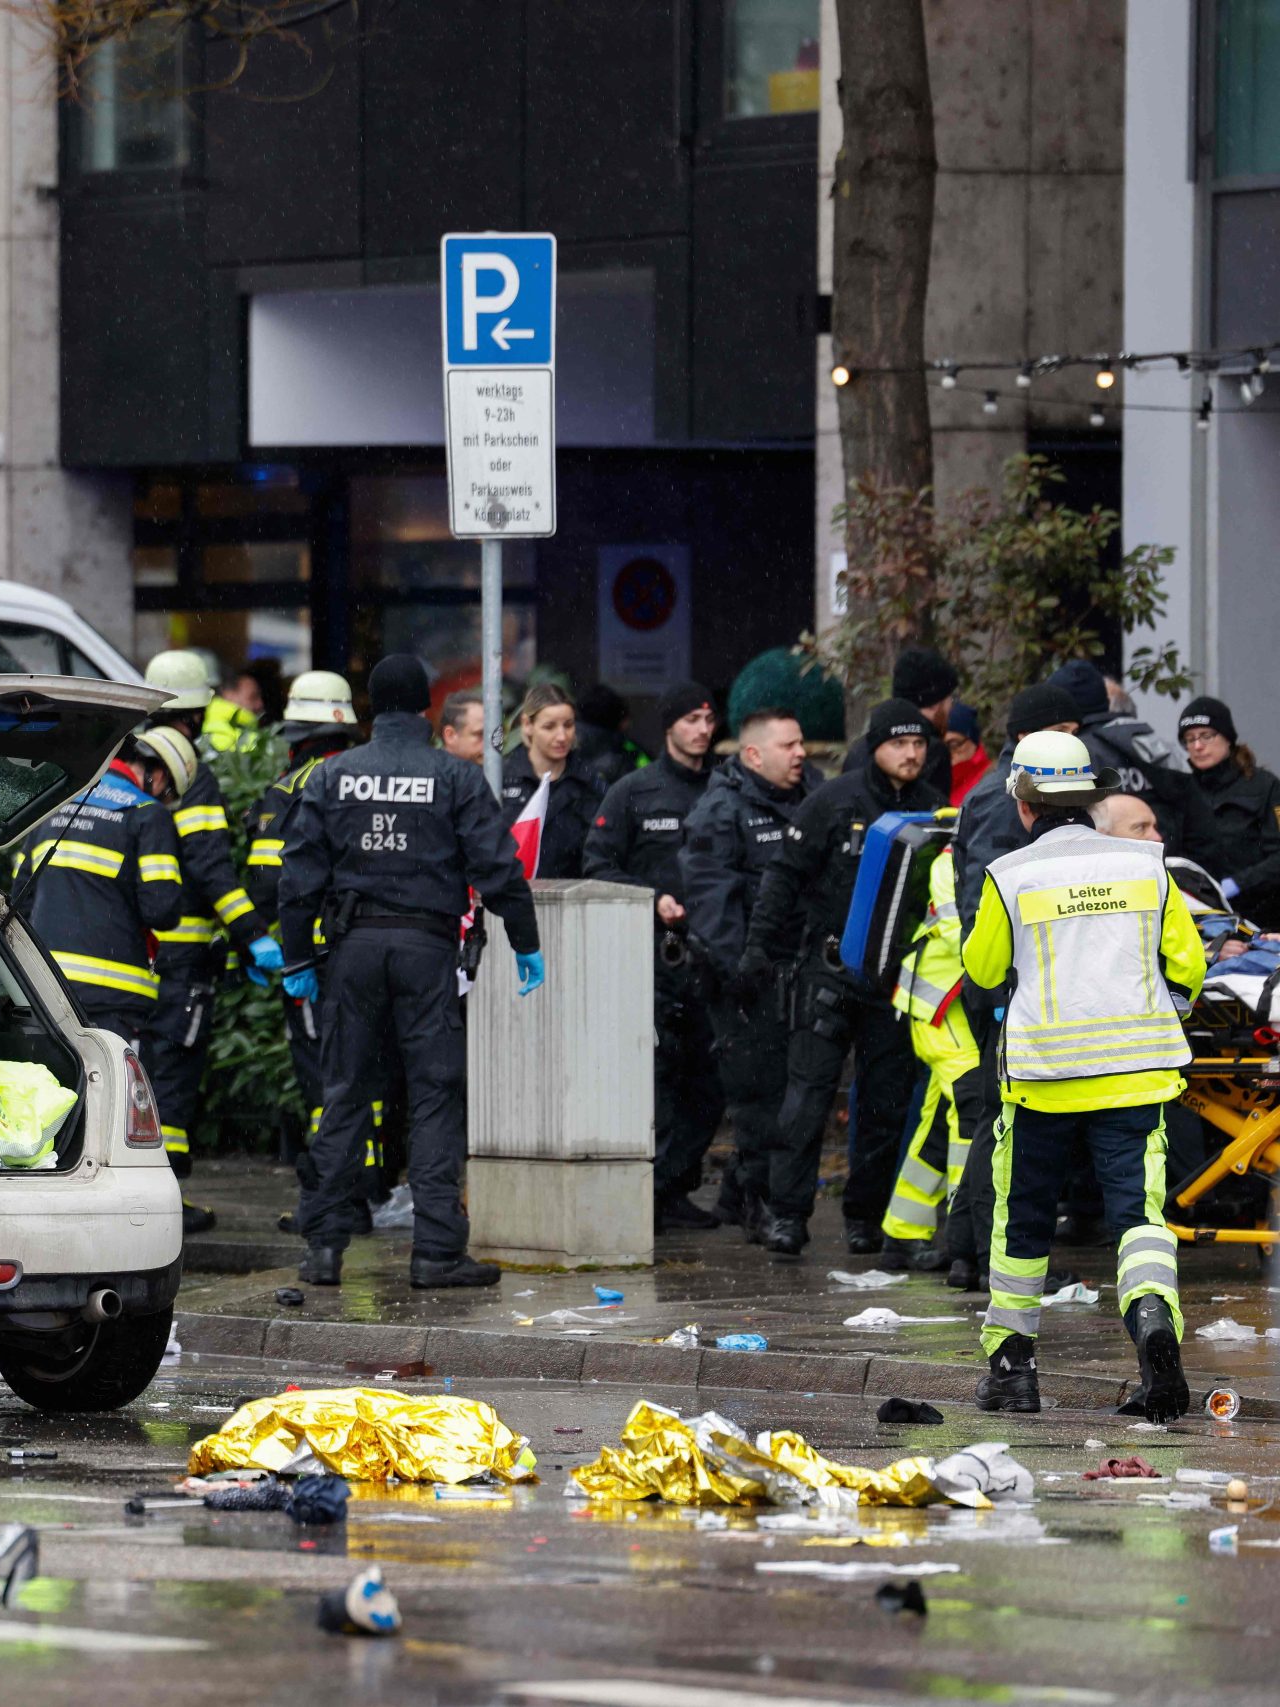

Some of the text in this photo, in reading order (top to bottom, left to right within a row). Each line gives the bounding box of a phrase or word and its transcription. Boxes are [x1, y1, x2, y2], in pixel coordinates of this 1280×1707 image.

[462, 252, 520, 351] P
[476, 383, 524, 401] werktags
[484, 407, 516, 423] 9-23h
[463, 433, 539, 447] mit Parkschein
[489, 458, 513, 472] oder
[471, 482, 533, 497] Parkausweis
[338, 774, 435, 804] POLIZEI
[372, 813, 398, 832] BY
[361, 832, 409, 851] 6243
[1068, 885, 1113, 900] Leiter
[1057, 898, 1128, 915] Ladezone
